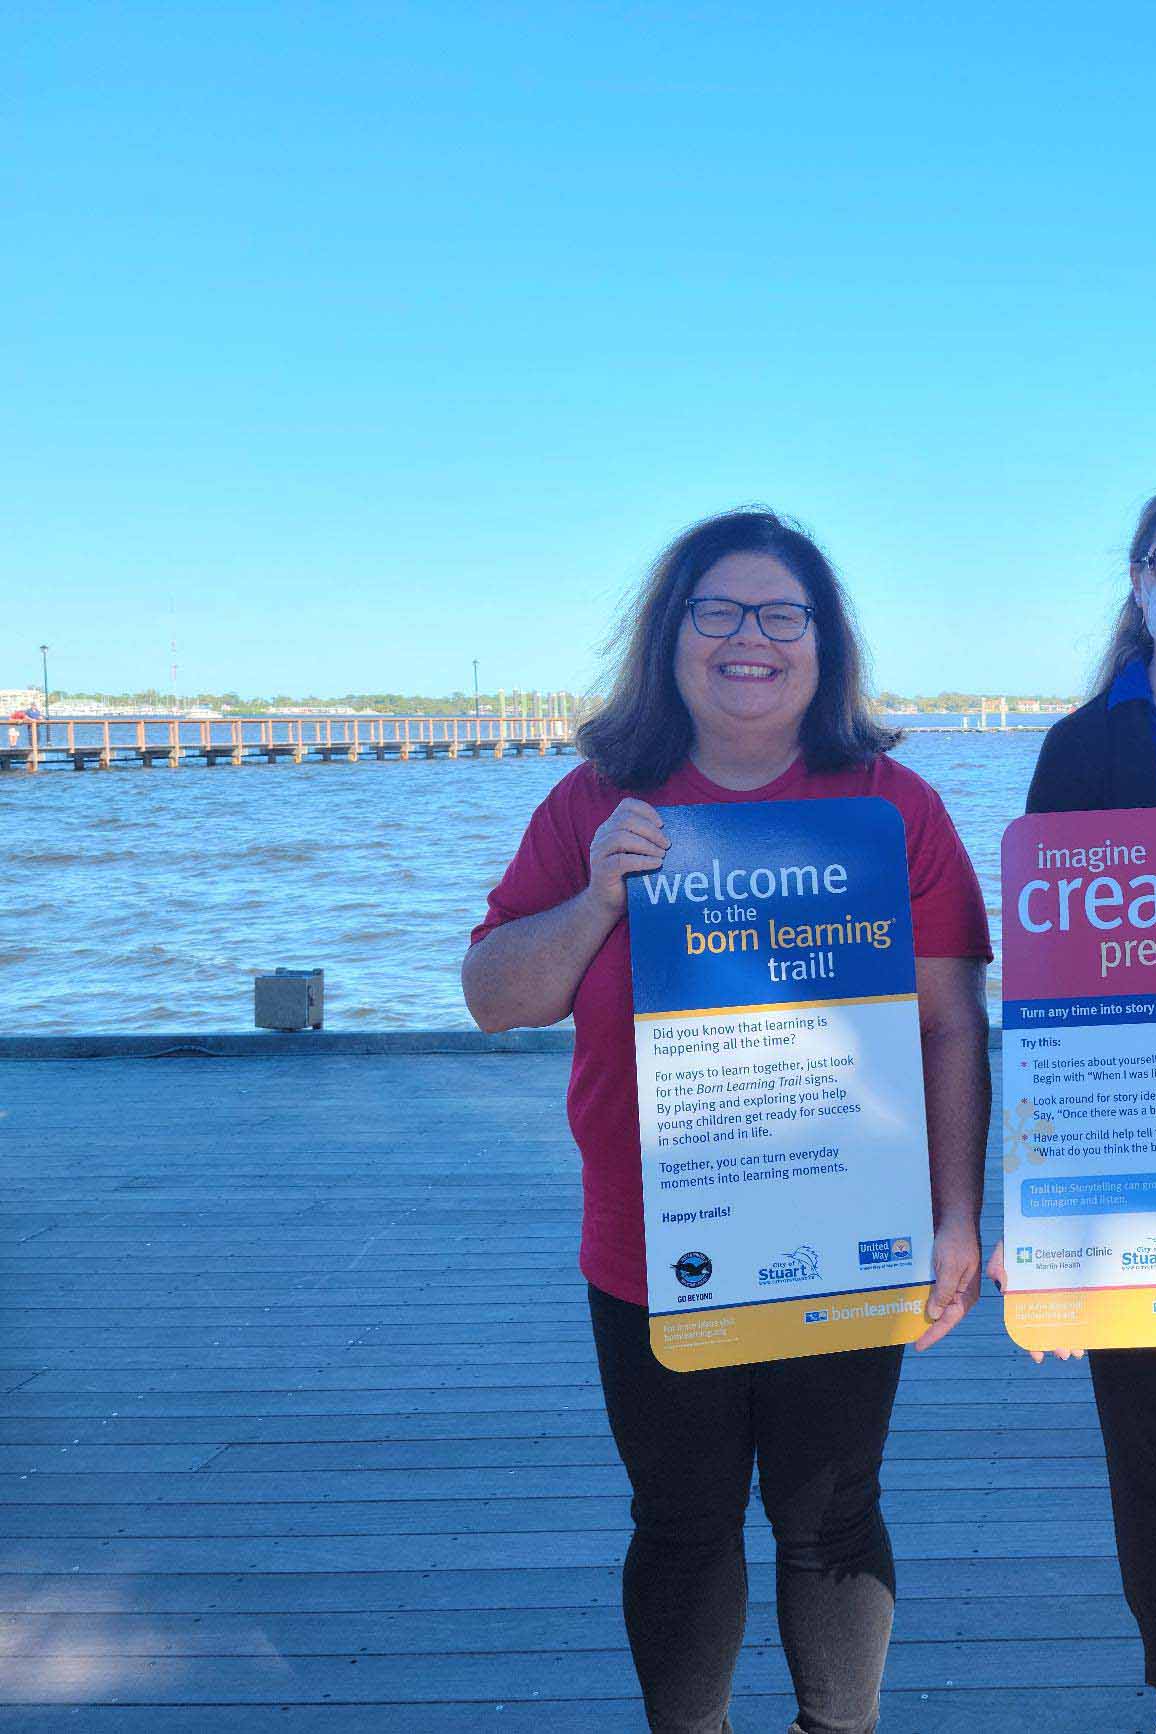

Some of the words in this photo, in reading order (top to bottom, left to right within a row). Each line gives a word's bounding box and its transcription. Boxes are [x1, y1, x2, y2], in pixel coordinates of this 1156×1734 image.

[1037, 840, 1146, 872] imagine
[644, 859, 847, 904] welcome
[702, 908, 721, 923] to
[726, 904, 756, 921] the
[686, 925, 757, 954] born
[770, 915, 890, 949] learning
[768, 952, 834, 982] trail!
[1020, 1008, 1044, 1017] Turn
[1048, 1008, 1068, 1018] any
[1071, 1005, 1097, 1015] time
[1100, 1004, 1122, 1014] into
[1125, 1004, 1154, 1014] story
[653, 1027, 673, 1039] Did
[676, 1028, 698, 1039] you
[702, 1025, 734, 1035] know
[738, 1022, 761, 1032] that
[765, 1018, 814, 1029] learning
[817, 1016, 826, 1026] is
[654, 1041, 719, 1055] happening
[723, 1038, 736, 1049] all
[740, 1037, 759, 1048] the
[763, 1033, 795, 1045] time?
[1021, 1038, 1035, 1049] Try
[1038, 1037, 1060, 1046] this:
[655, 1071, 671, 1081] For
[675, 1070, 704, 1080] ways
[707, 1068, 718, 1077] to
[721, 1066, 749, 1075] learn
[753, 1061, 803, 1073] together,
[807, 1058, 826, 1070] just
[830, 1055, 853, 1066] look
[1034, 1059, 1048, 1068] Tell
[1051, 1058, 1084, 1069] stories
[1087, 1057, 1116, 1067] about
[1118, 1054, 1156, 1066] yourself
[656, 1087, 671, 1097] for
[674, 1085, 692, 1095] the
[696, 1084, 722, 1094] Born
[726, 1079, 774, 1091] Learning
[780, 1075, 801, 1086] Trail
[805, 1074, 837, 1085] signs.
[1033, 1073, 1060, 1084] Begin
[1063, 1072, 1084, 1081] with
[1123, 1070, 1126, 1079] I
[657, 1103, 670, 1115] By
[674, 1100, 715, 1114] playing
[718, 1096, 739, 1110] and
[743, 1093, 795, 1106] exploring
[798, 1092, 818, 1103] you
[822, 1088, 846, 1099] help
[1033, 1096, 1056, 1106] Look
[1058, 1093, 1093, 1103] around
[1096, 1093, 1109, 1102] for
[1113, 1093, 1137, 1102] story
[657, 1120, 692, 1131] young
[696, 1114, 741, 1125] children
[745, 1112, 761, 1124] get
[766, 1108, 796, 1119] ready
[799, 1106, 814, 1116] for
[818, 1104, 860, 1115] success
[1033, 1110, 1053, 1121] Say,
[1090, 1107, 1116, 1116] there
[1141, 1106, 1147, 1114] a
[658, 1136, 668, 1145] in
[672, 1132, 709, 1144] school
[713, 1129, 734, 1141] and
[737, 1128, 747, 1138] in
[751, 1126, 771, 1136] life.
[659, 1160, 713, 1174] Together,
[716, 1158, 737, 1169] you
[740, 1156, 759, 1164] can
[762, 1153, 785, 1162] turn
[789, 1147, 838, 1160] everyday
[660, 1176, 714, 1188] moments
[717, 1173, 739, 1182] into
[743, 1168, 789, 1180] learning
[792, 1163, 847, 1175] moments.
[662, 1212, 696, 1223] Happy
[699, 1206, 729, 1218] trails!
[861, 1240, 889, 1252] United
[872, 1251, 889, 1260] Way
[759, 1265, 807, 1280] Stuart
